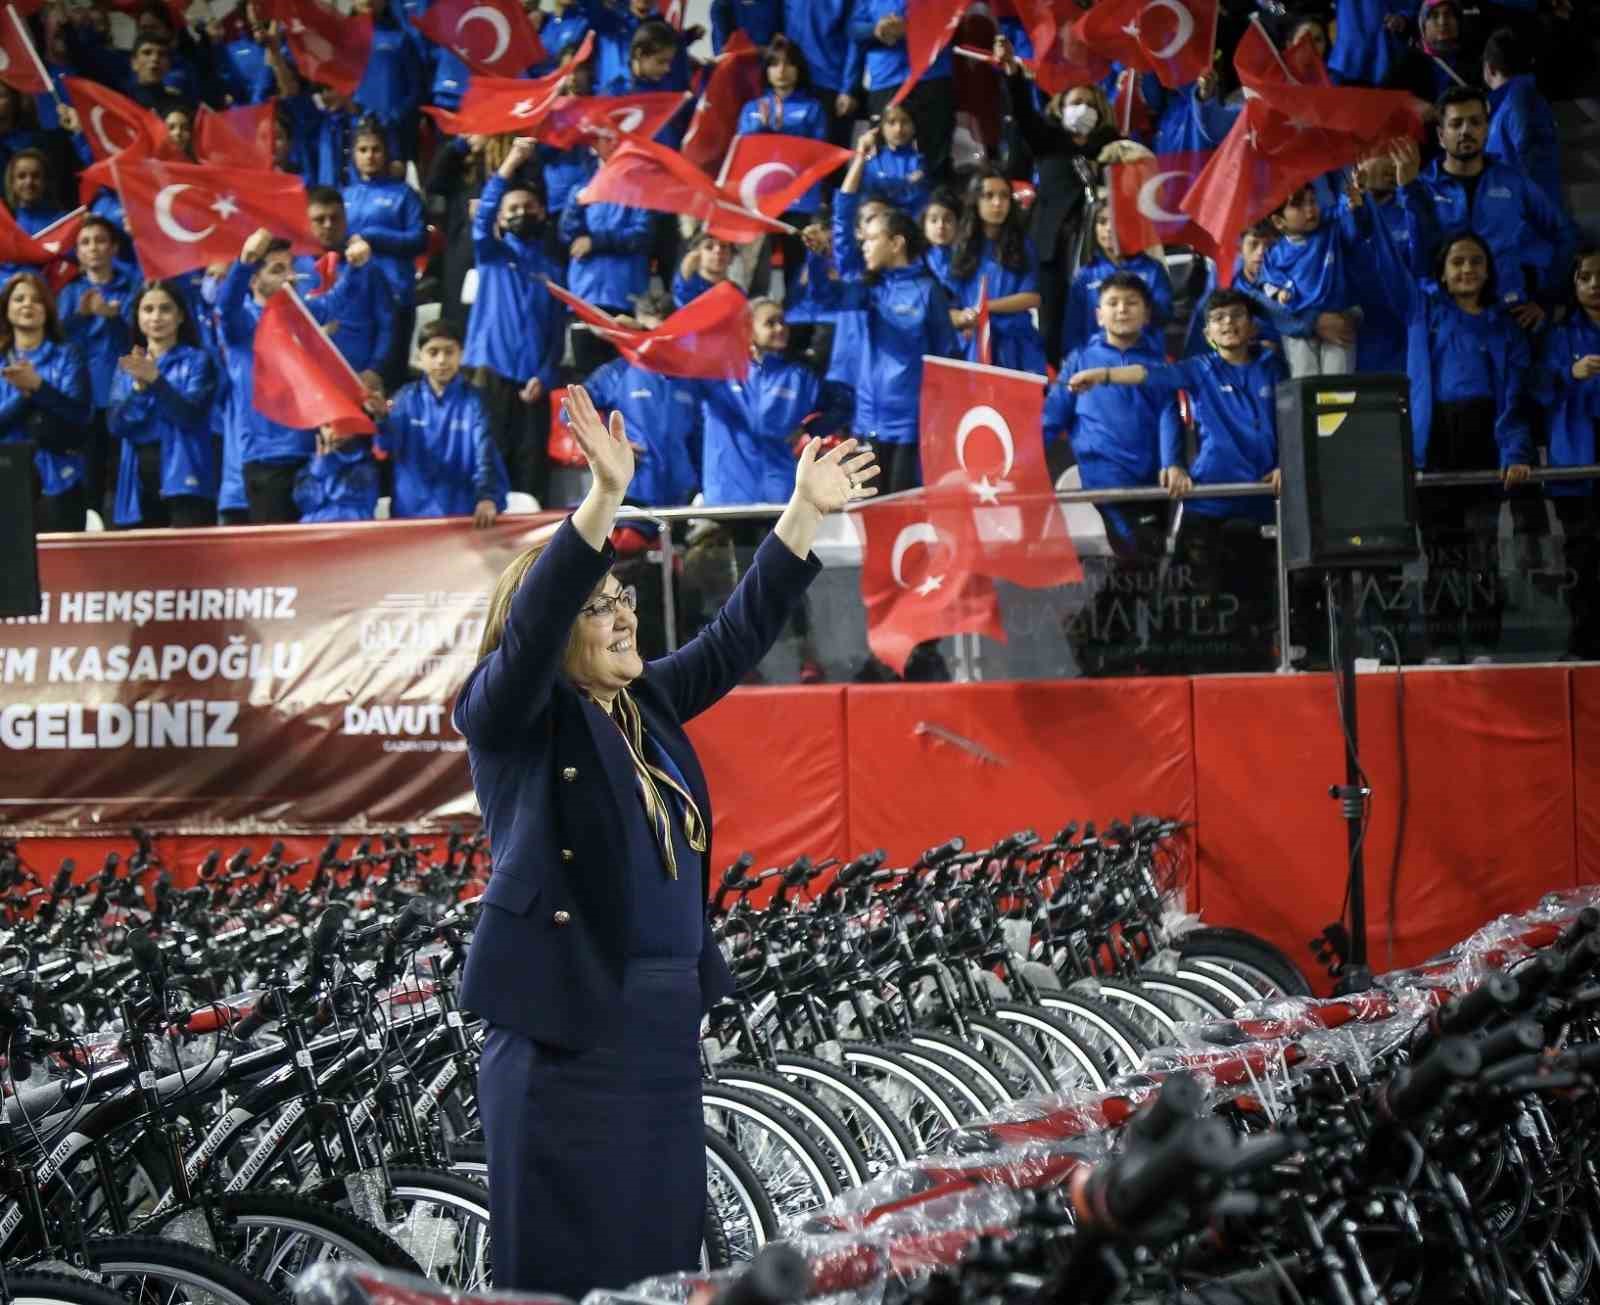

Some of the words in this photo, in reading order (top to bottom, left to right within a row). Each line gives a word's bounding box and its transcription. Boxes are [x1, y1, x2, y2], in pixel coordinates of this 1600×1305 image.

[59, 587, 298, 626] HEMŞEHRİMİZ
[0, 647, 39, 684] M
[47, 635, 303, 682] KASAPOĞLU
[0, 701, 240, 750] GELDİNİZ
[343, 703, 446, 735] DAVUT
